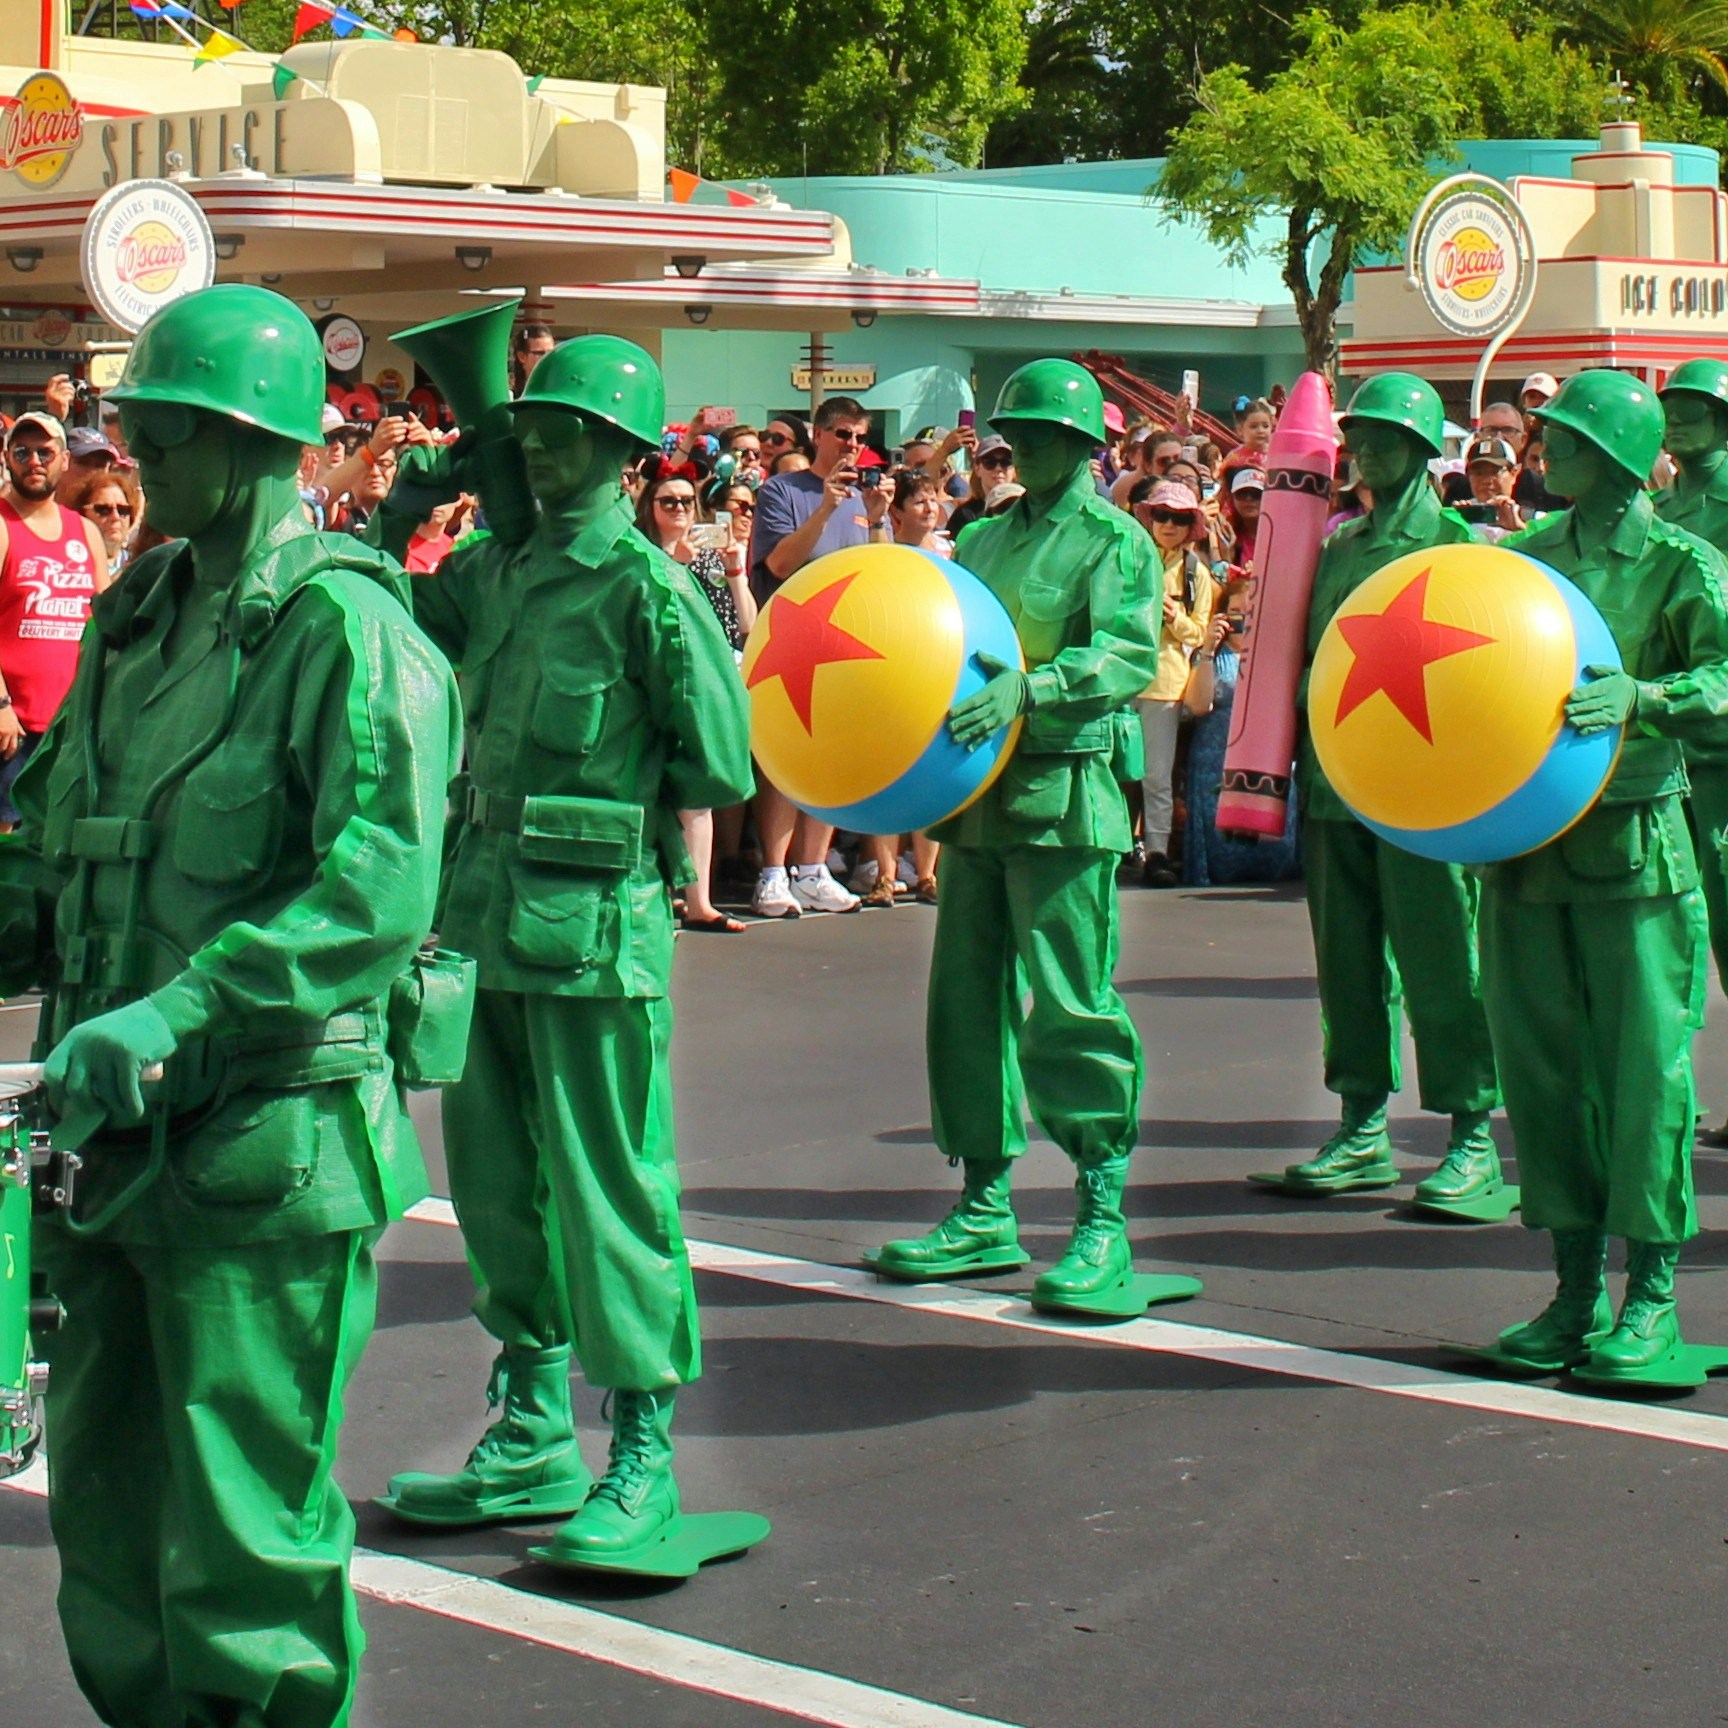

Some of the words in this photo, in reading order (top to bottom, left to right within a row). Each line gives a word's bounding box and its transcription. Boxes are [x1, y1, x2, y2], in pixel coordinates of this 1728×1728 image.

[101, 106, 288, 188] SERVICE
[106, 199, 145, 249] STROLLERS
[152, 198, 200, 253] WHEELCHAIRS
[116, 234, 187, 284] Oscar's
[1435, 240, 1505, 290] Oscar's
[114, 284, 153, 317] ELECTRIC
[1621, 273, 1659, 316] ICE
[1670, 276, 1725, 319] COLD
[33, 555, 95, 589] Pizza
[16, 580, 91, 618] Planet
[21, 623, 60, 637] DELIVERY
